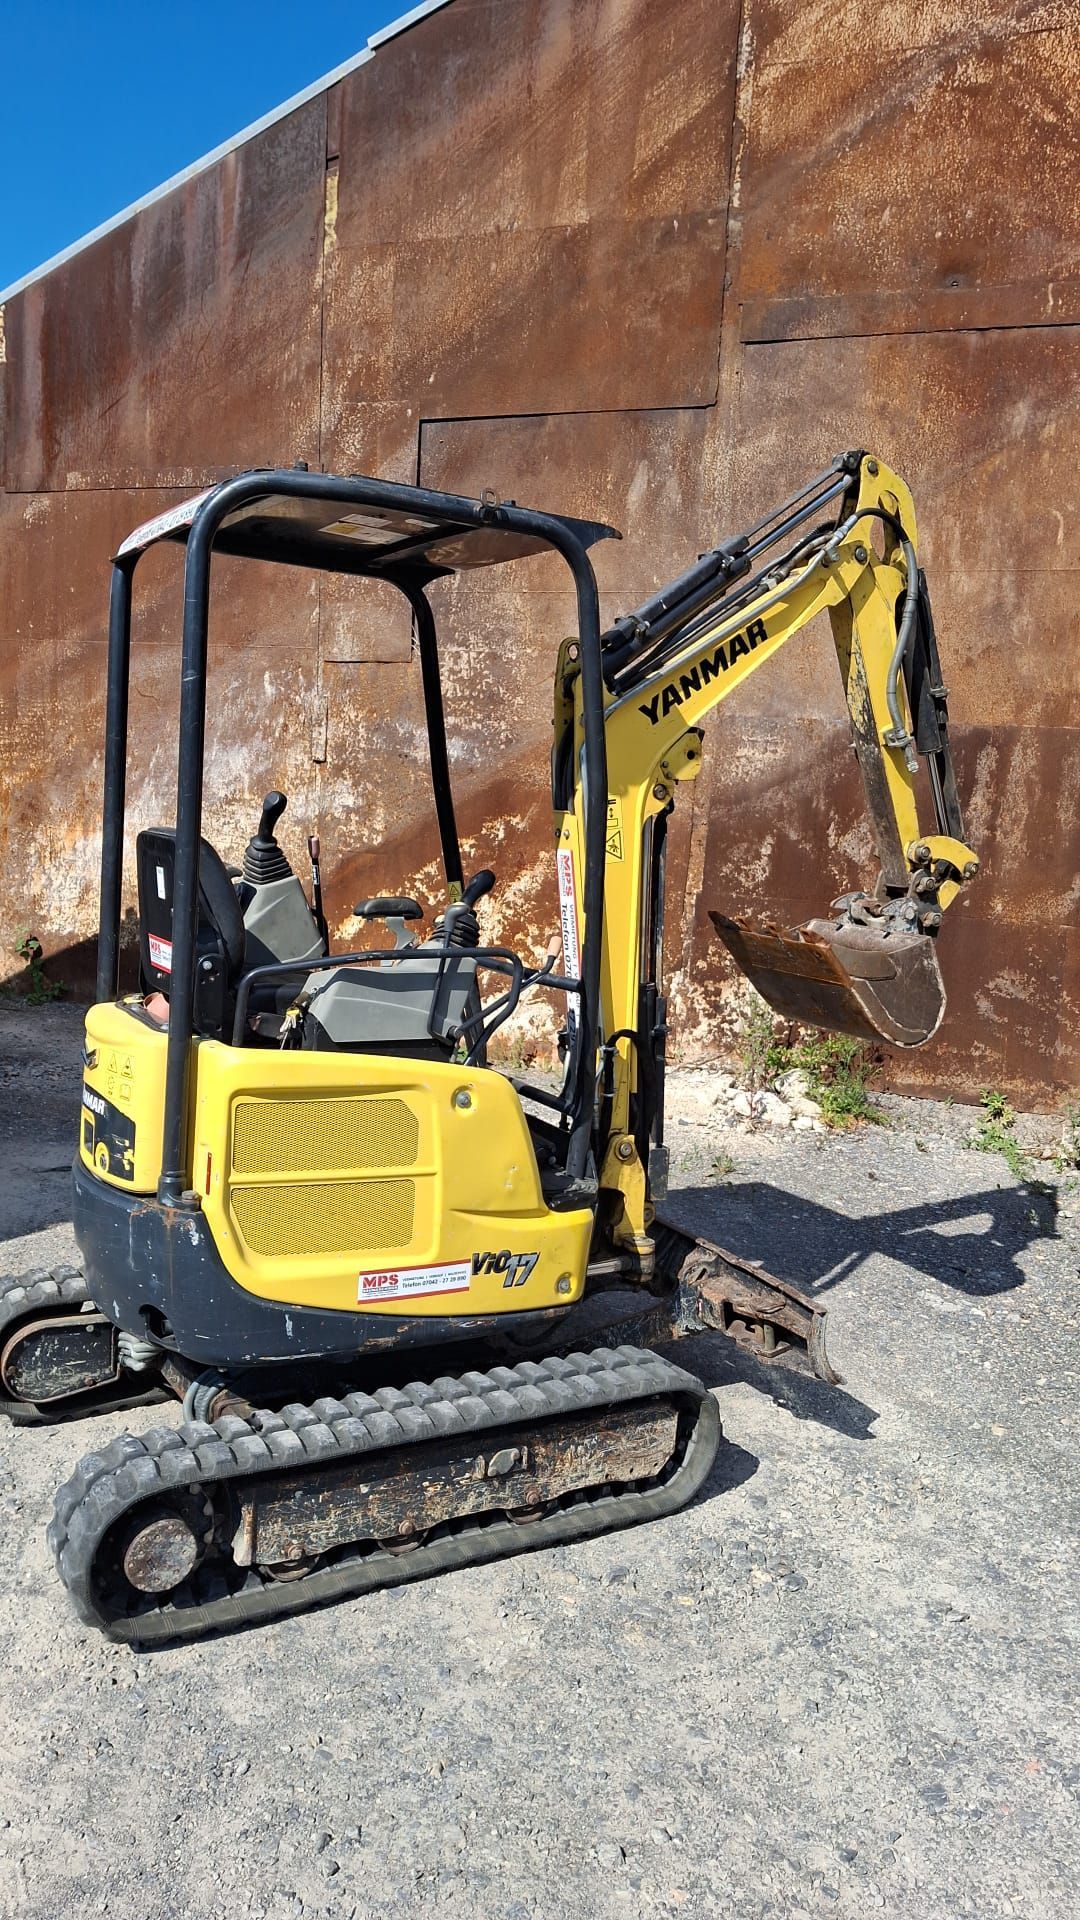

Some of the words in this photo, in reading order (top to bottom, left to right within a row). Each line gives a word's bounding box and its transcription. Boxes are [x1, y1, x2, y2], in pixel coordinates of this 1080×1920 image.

[638, 618, 768, 725] YANMAR
[563, 854, 573, 897] MPS
[562, 903, 570, 951] Telefon
[362, 1274, 399, 1289] MPS
[402, 1281, 422, 1289] Telefon
